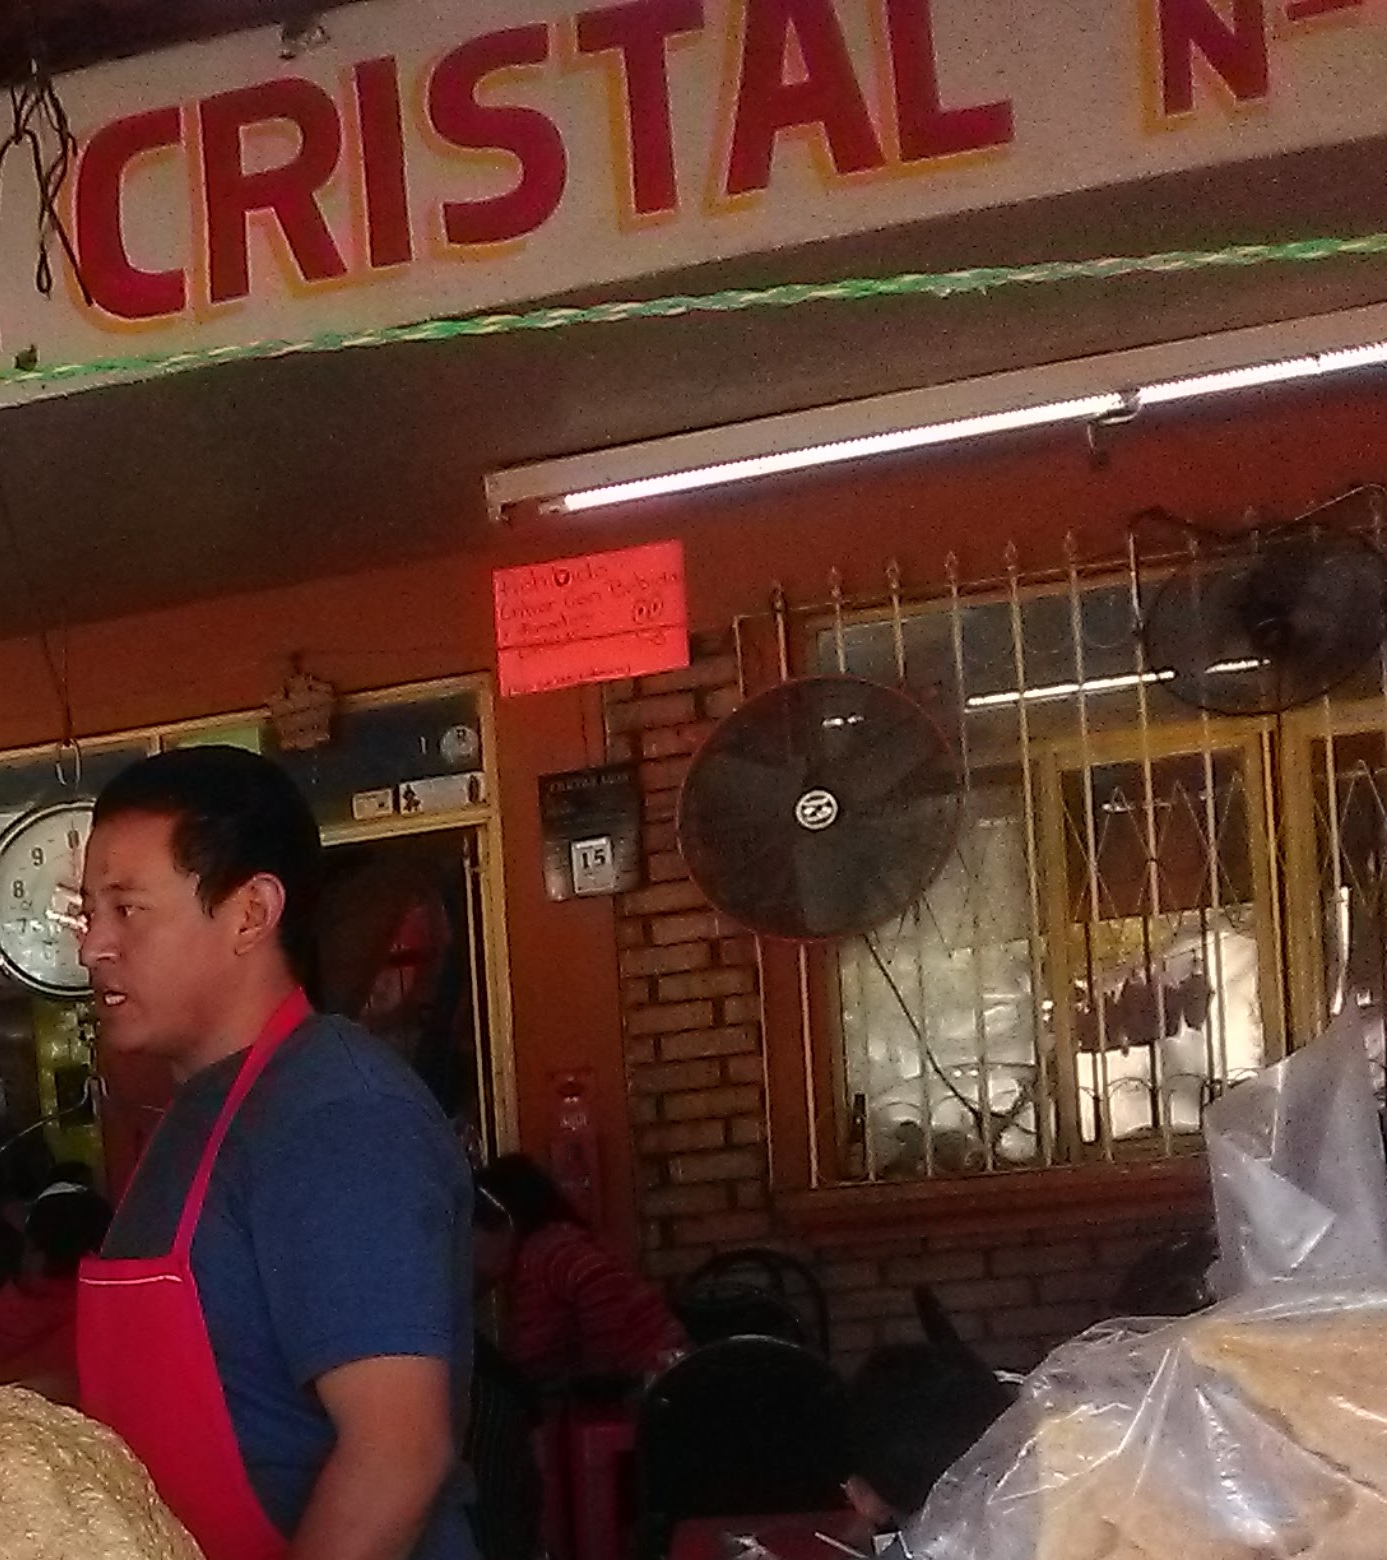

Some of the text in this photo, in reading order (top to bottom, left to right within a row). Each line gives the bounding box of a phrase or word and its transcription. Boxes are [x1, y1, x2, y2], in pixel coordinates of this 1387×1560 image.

[73, 0, 1015, 328] CRISTAL
[31, 847, 45, 867] 9
[581, 848, 606, 870] 15
[12, 879, 25, 899] 8
